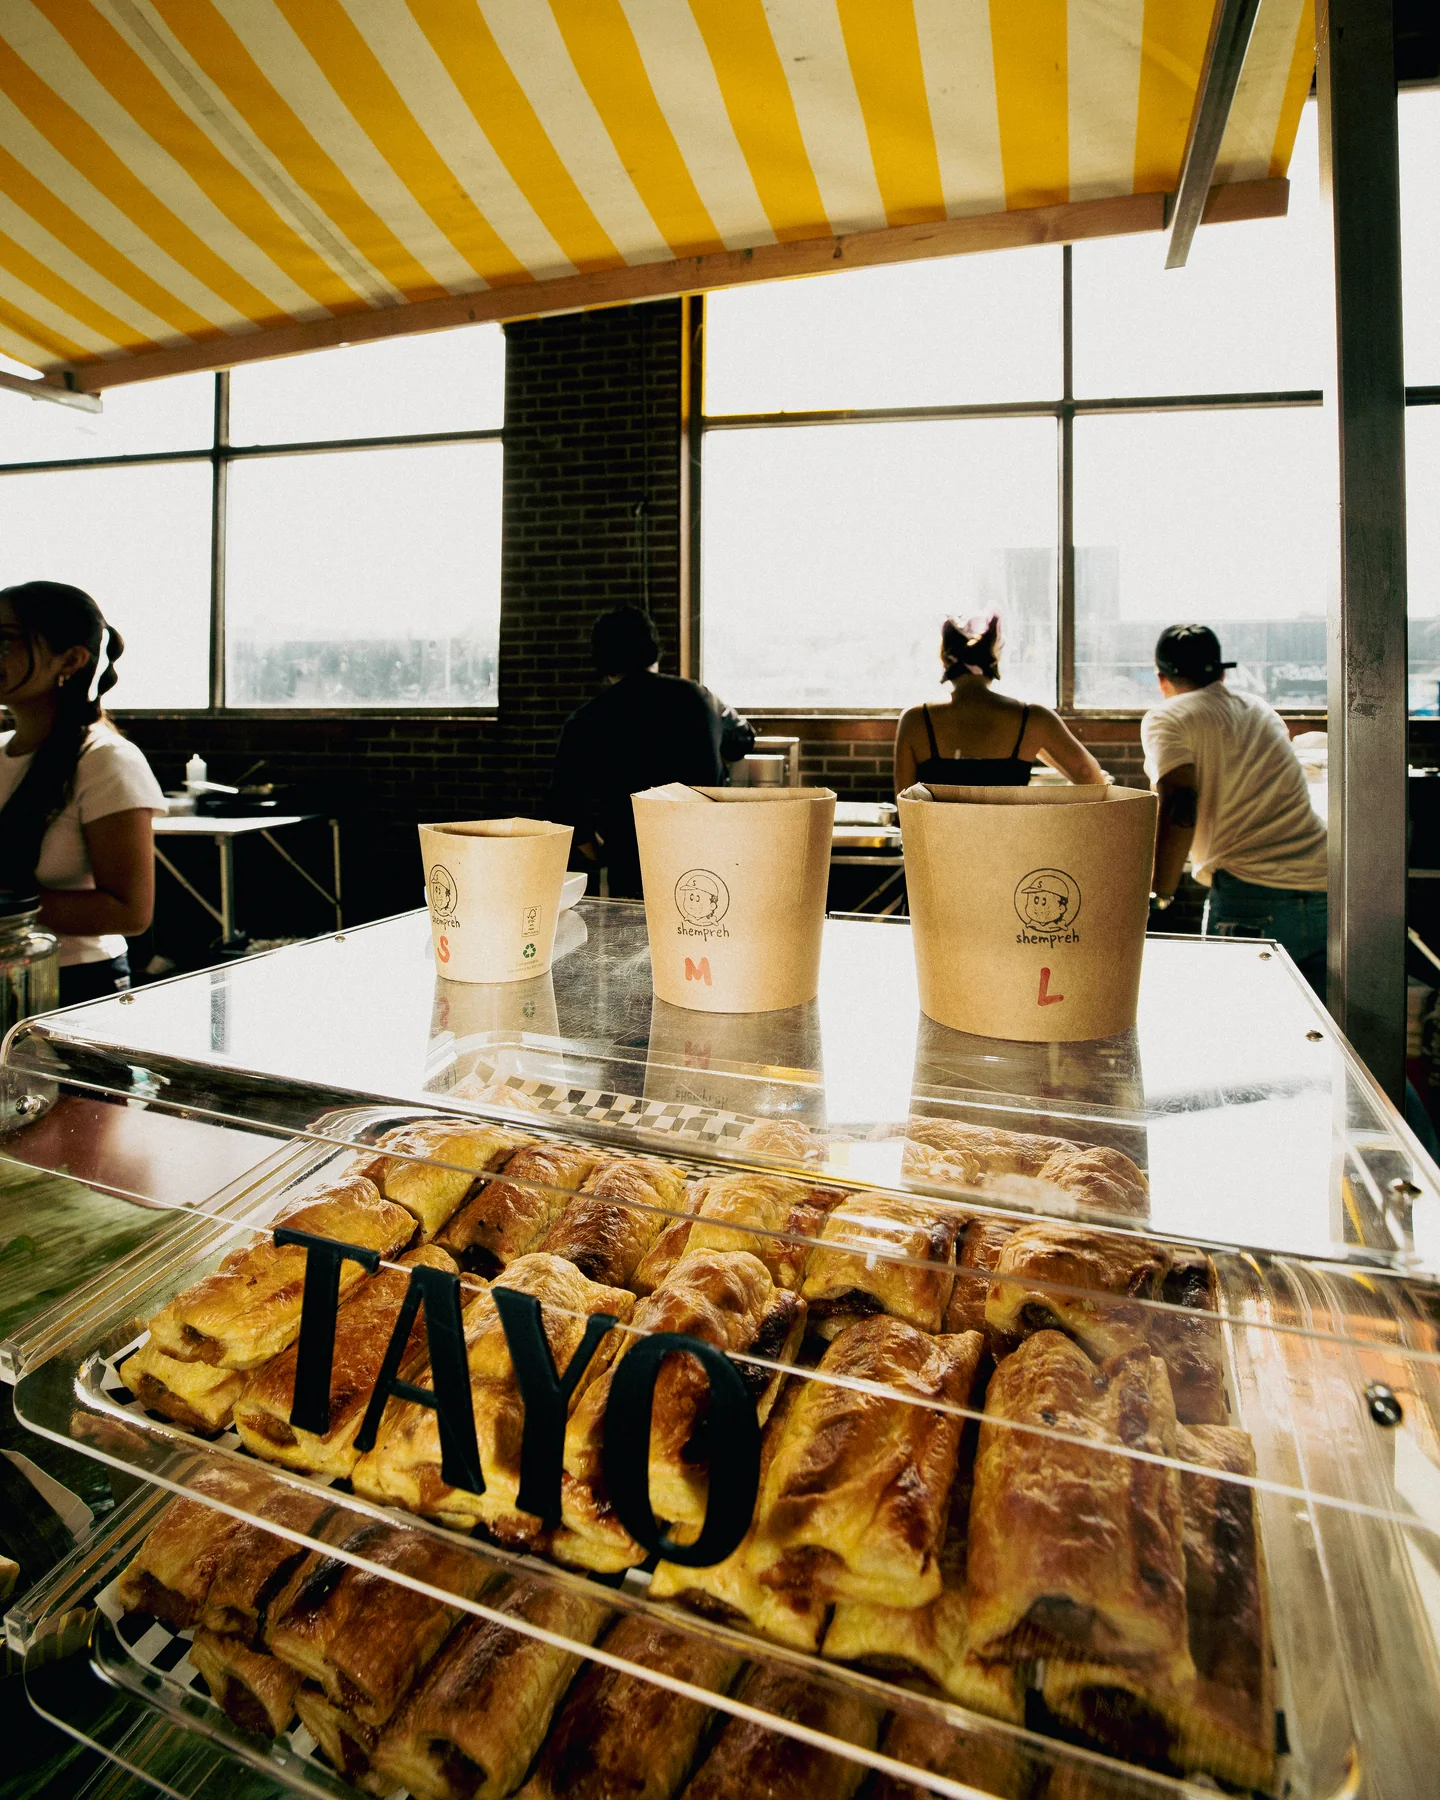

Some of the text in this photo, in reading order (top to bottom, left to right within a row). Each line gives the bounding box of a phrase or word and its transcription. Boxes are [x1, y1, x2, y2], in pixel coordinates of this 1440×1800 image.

[677, 922, 730, 942] shempreh
[1016, 928, 1080, 949] shempreh
[437, 935, 451, 963] S
[684, 956, 713, 986] M
[1037, 966, 1064, 1006] L
[274, 1228, 762, 1567] TAYO
